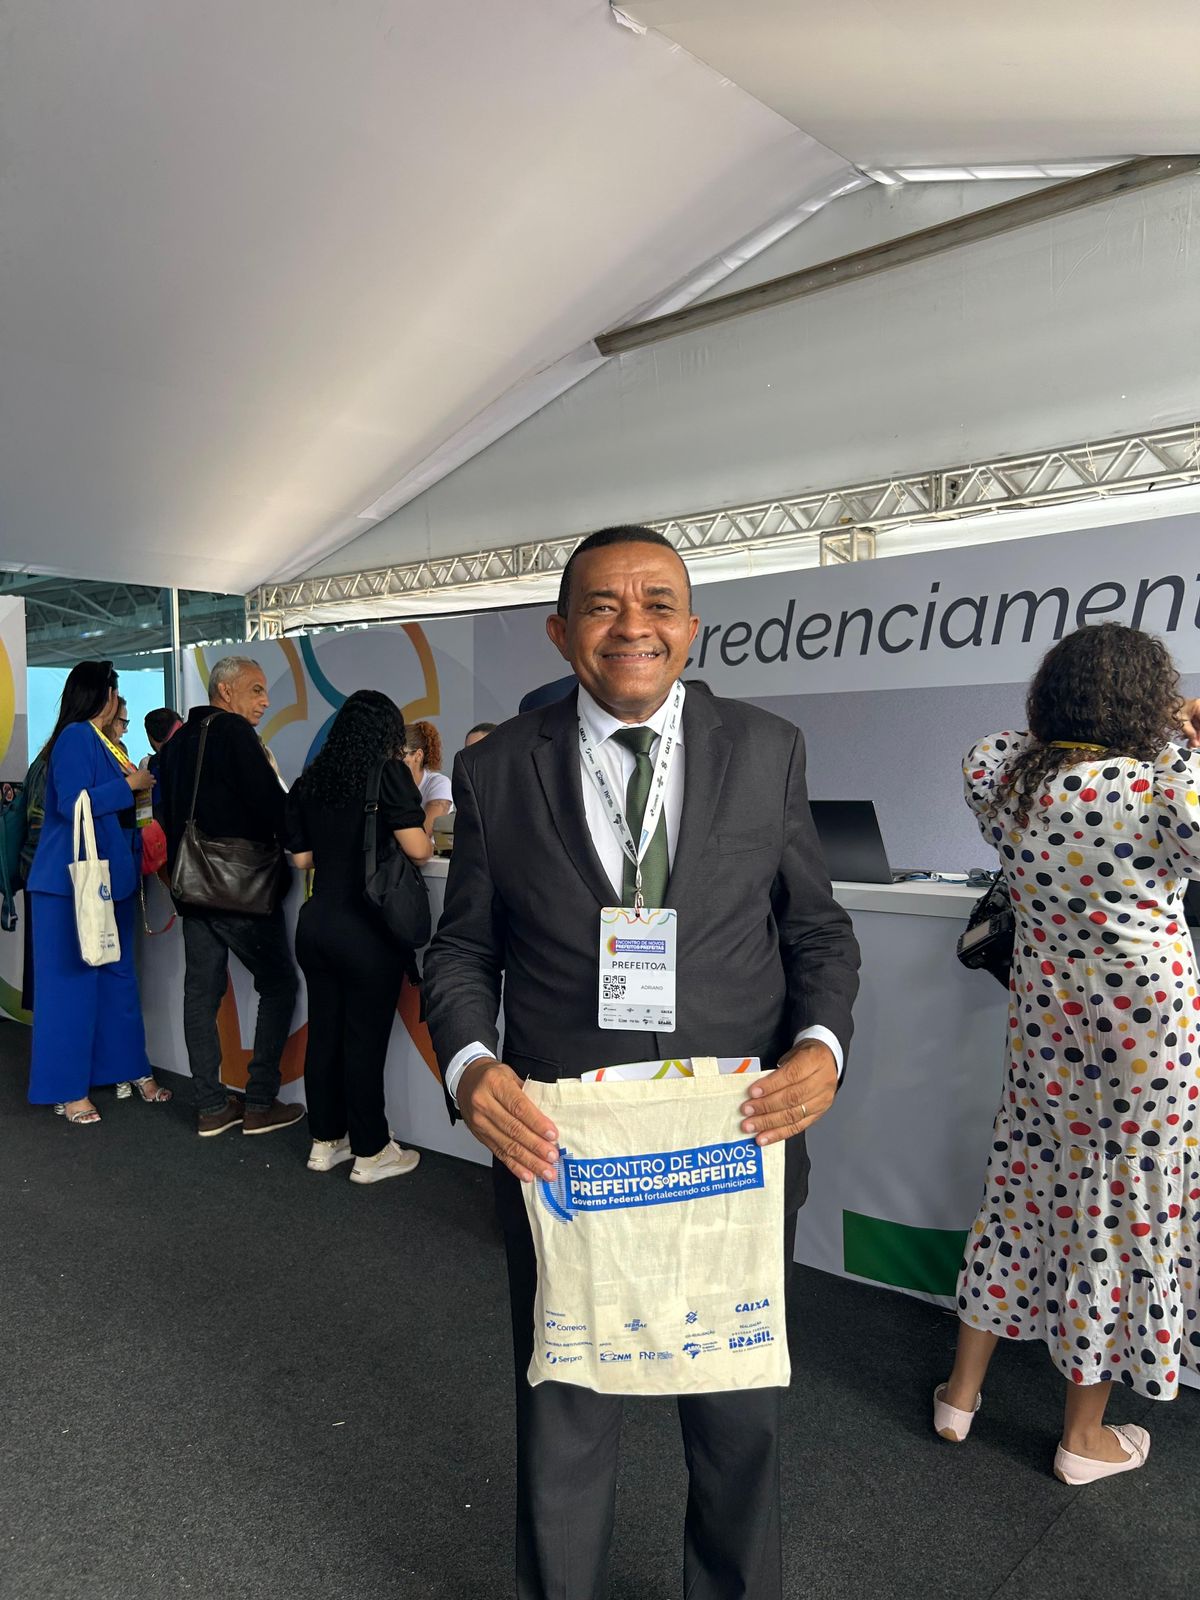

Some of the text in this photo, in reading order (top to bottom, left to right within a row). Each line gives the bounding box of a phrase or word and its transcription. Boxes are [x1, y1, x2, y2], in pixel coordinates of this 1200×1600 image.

[611, 960, 667, 970] PREFEITO/A
[568, 1144, 756, 1179] ENCONTRO DE NOVOS
[570, 1160, 757, 1196] PREFEITOS PREFEITAS
[572, 1196, 607, 1206] Governo
[608, 1194, 643, 1204] Federal
[644, 1187, 699, 1201] fortalecendo
[735, 1298, 770, 1313] CAIXA
[729, 1330, 775, 1349] BRASIL
[558, 1355, 582, 1364] Serpro
